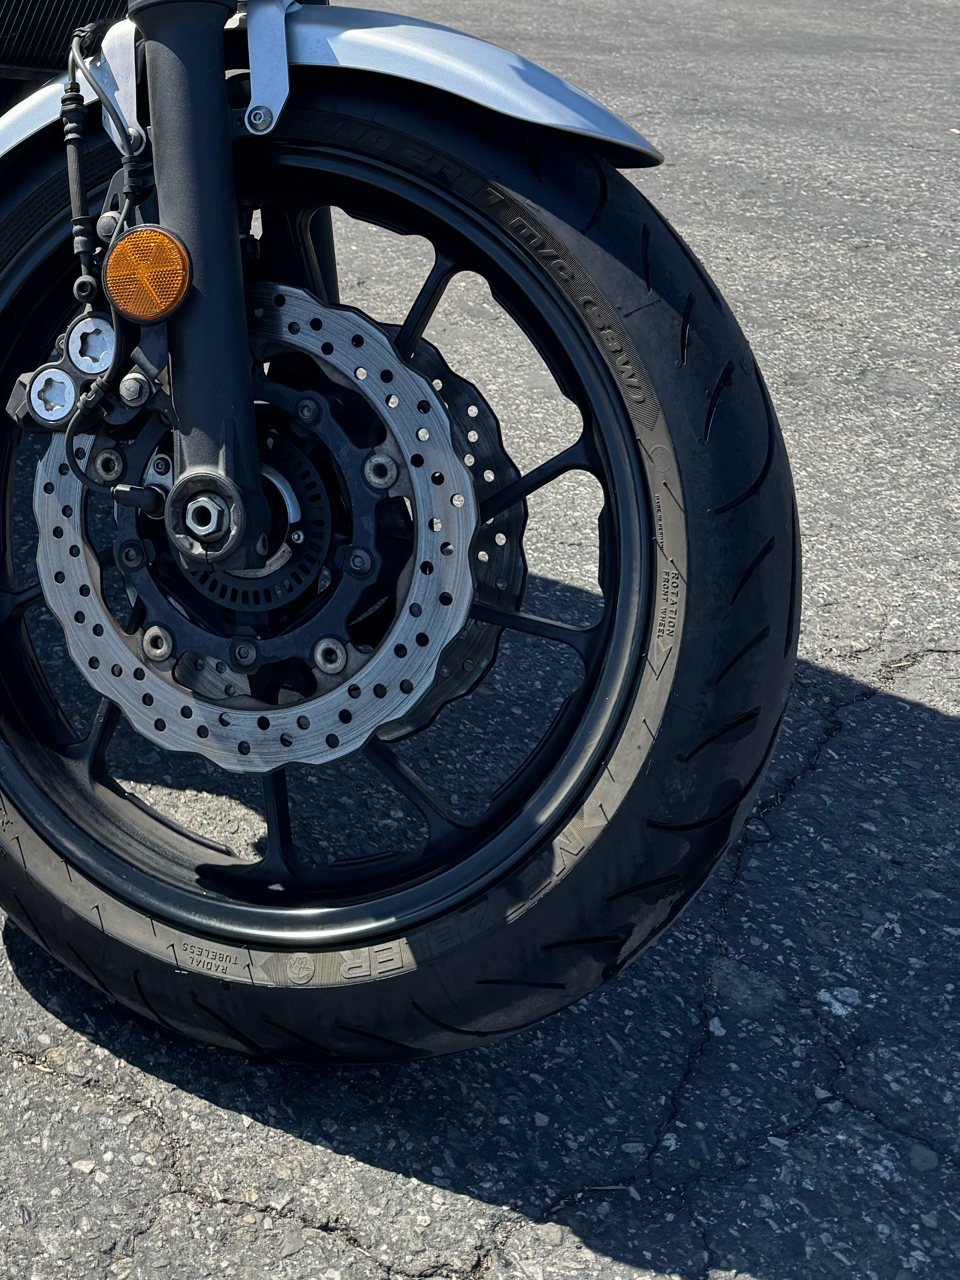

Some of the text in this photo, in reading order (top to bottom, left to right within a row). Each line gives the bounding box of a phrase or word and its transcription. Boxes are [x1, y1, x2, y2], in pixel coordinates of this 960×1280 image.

[657, 571, 670, 640] FRONT WHEEL
[666, 572, 680, 638] ROTATION
[180, 942, 240, 966] TUBELESS
[188, 955, 229, 975] RADIAL
